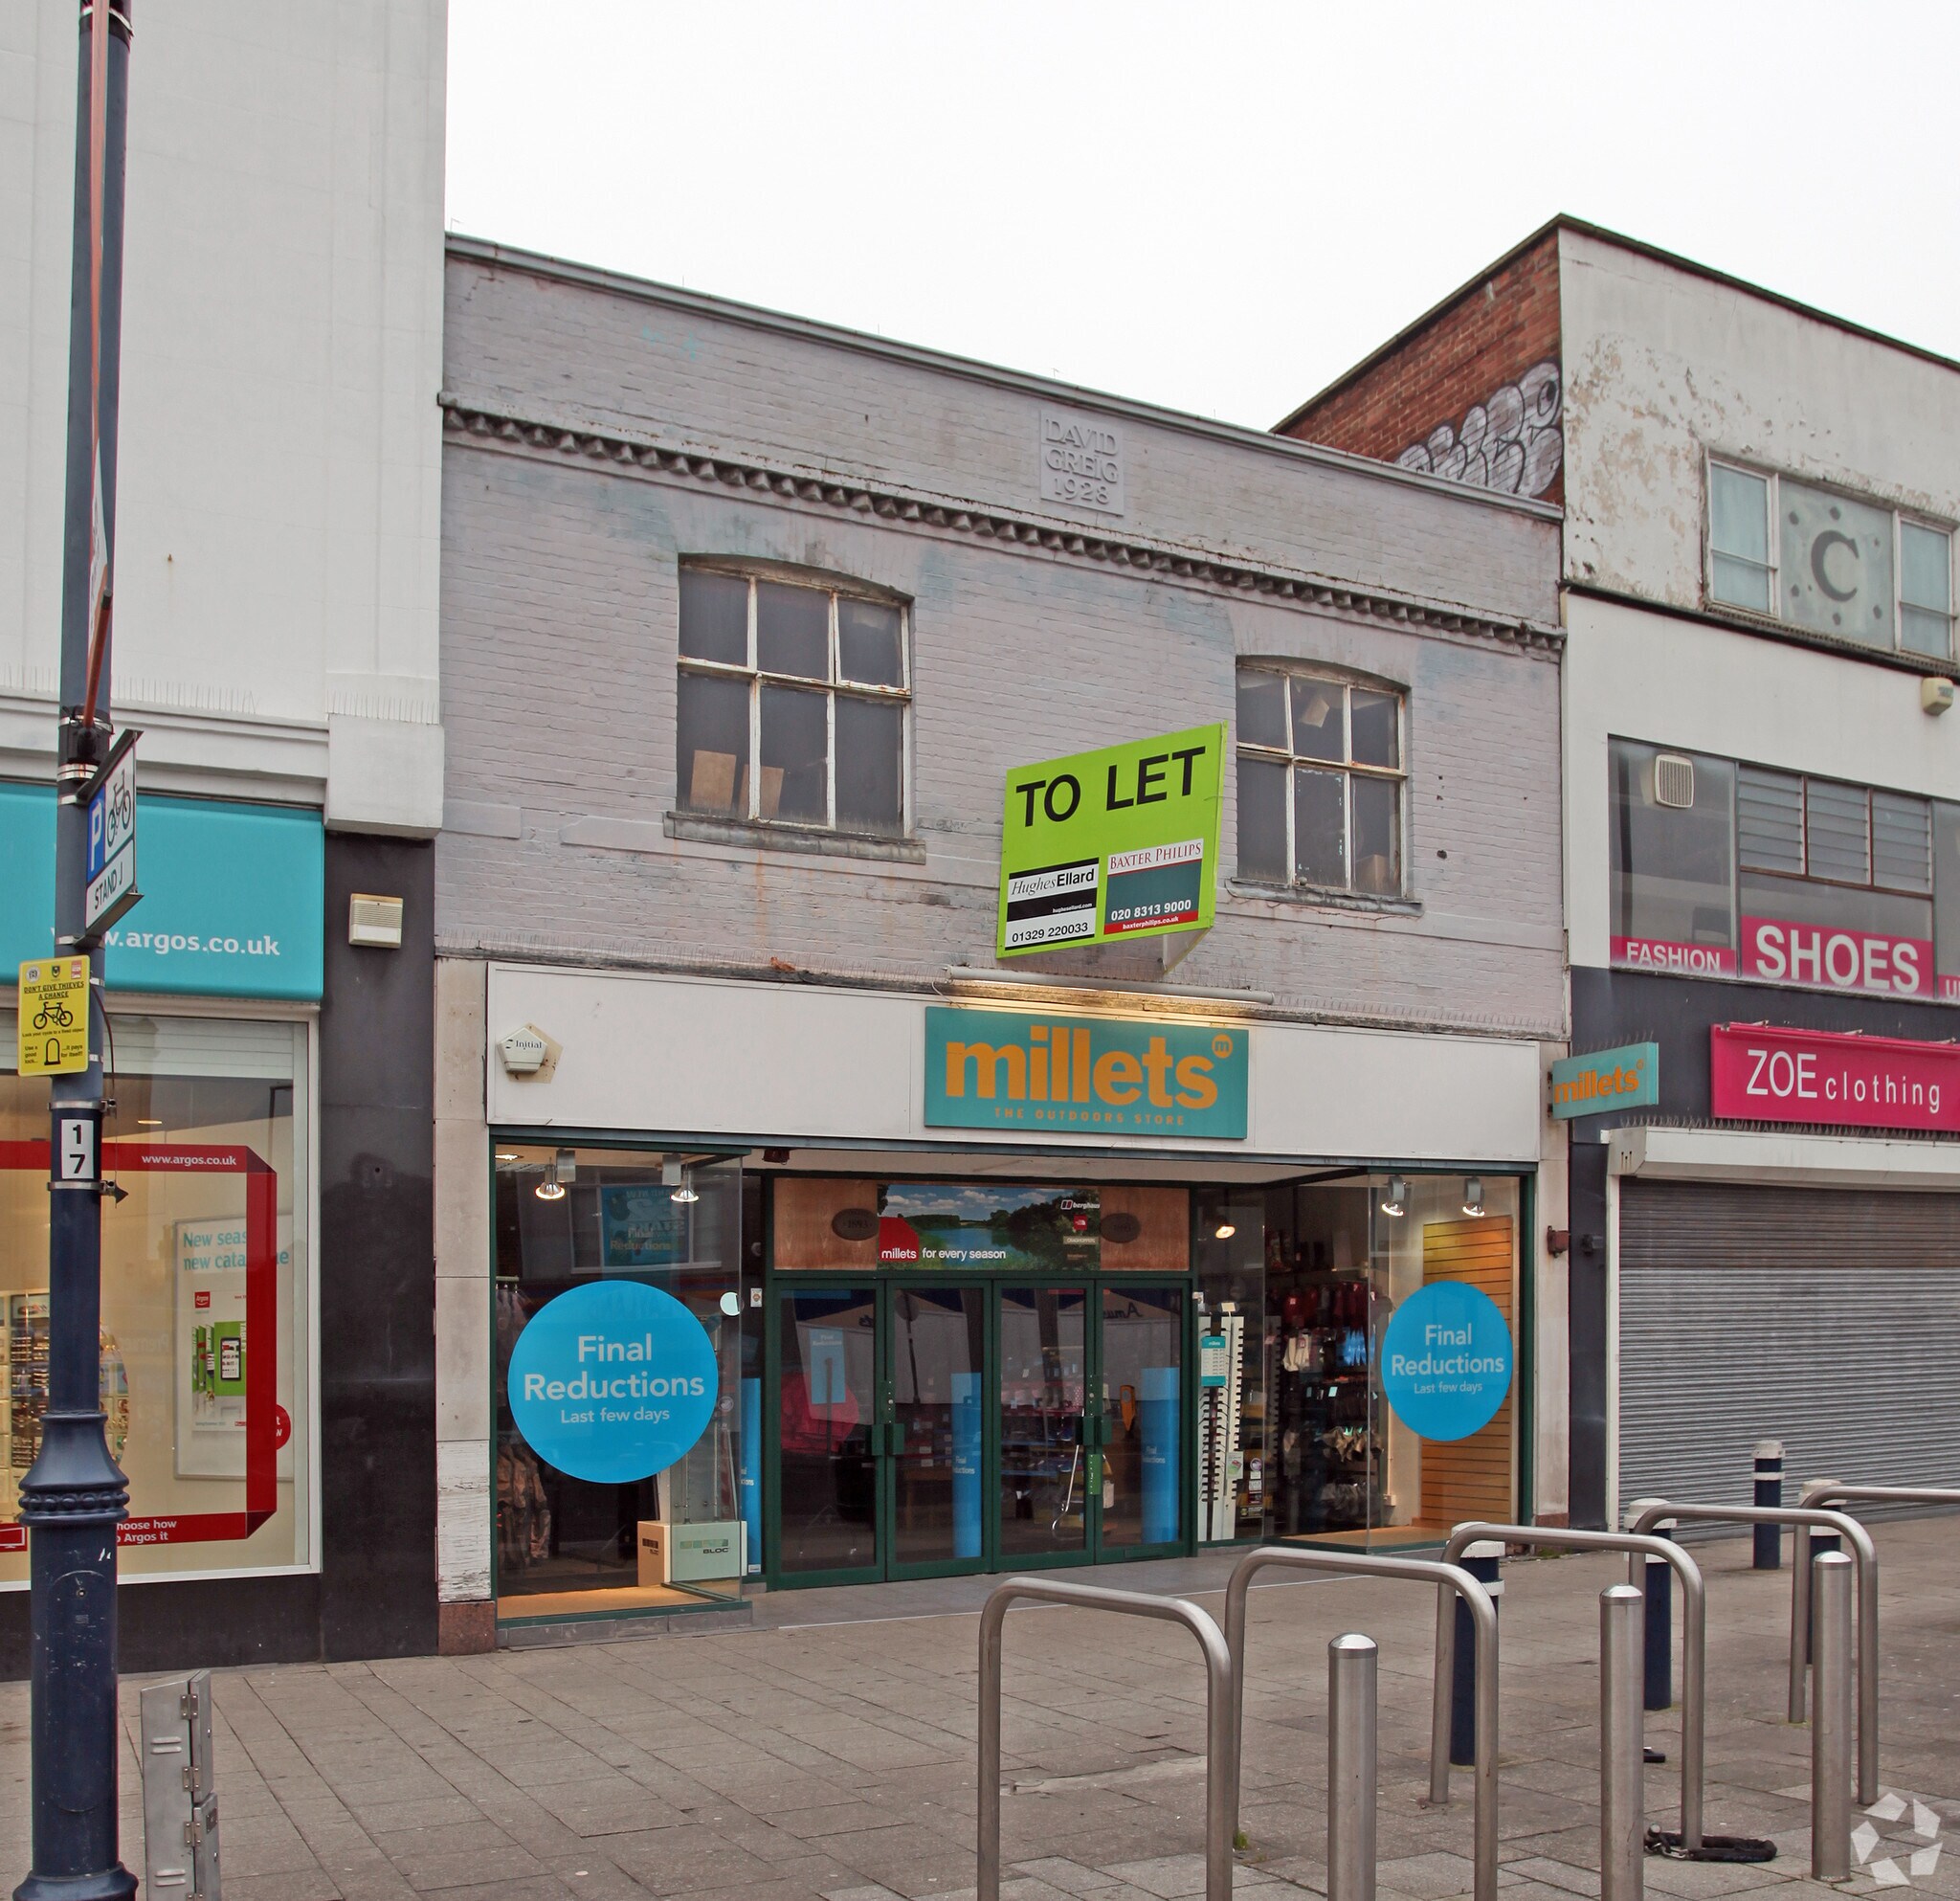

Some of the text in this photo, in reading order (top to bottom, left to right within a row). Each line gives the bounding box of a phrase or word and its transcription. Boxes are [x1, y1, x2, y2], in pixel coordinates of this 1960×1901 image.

[1045, 418, 1118, 457] DAVID
[1045, 449, 1118, 484] GREIG
[1055, 479, 1109, 504] 1928
[1015, 746, 1206, 827] TO LET
[90, 799, 102, 871] P
[1110, 842, 1202, 870] BAXTER PHILIPS
[94, 868, 118, 909] STAND
[1111, 900, 1192, 921] 020 8313 9000
[1012, 923, 1088, 942] 01329 220033
[1122, 916, 1179, 930] baxterphilips.co.uk
[105, 930, 280, 955] w.argos.co.uk
[1626, 941, 1722, 972] FASHION
[1756, 925, 1921, 994] SHOES
[58, 981, 84, 990] THIEVES
[516, 1040, 543, 1049] Initial
[946, 1025, 1218, 1109] millets
[1554, 1065, 1639, 1104] millets
[1747, 1049, 1941, 1114] ZOE clothing
[994, 1107, 1185, 1126] THE OUTDOORS STORE
[73, 1124, 82, 1144] 1
[69, 1154, 85, 1174] 7
[142, 1155, 237, 1166] www.argos.co.uk
[184, 1232, 212, 1247] New
[184, 1257, 210, 1270] new
[881, 1247, 1006, 1262] millets for every season
[1425, 1323, 1472, 1346] Final
[578, 1333, 652, 1362] Final
[1392, 1353, 1504, 1376] Reductions
[524, 1371, 704, 1400] Reductions
[1414, 1381, 1482, 1394] Last few days
[561, 1406, 670, 1424] Last few days
[117, 1519, 177, 1531] hoose how
[123, 1533, 157, 1545] Argos
[160, 1531, 168, 1540] it
